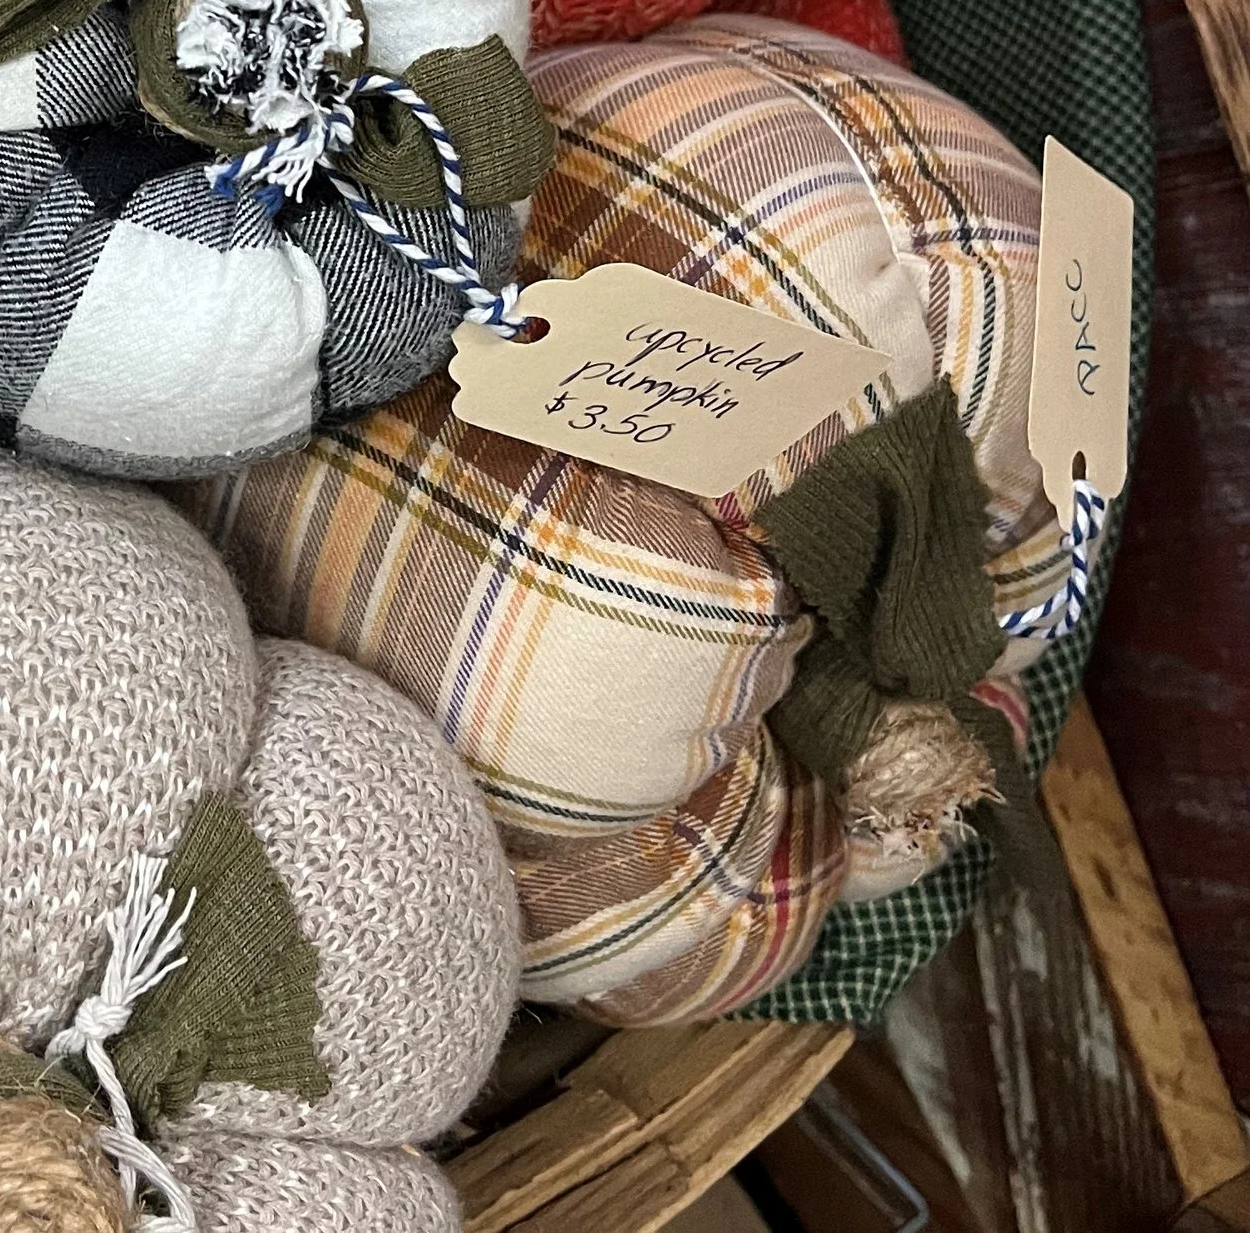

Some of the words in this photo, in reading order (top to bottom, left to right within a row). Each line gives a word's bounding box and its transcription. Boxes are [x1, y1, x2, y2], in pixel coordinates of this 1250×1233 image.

[625, 321, 805, 381] upcycled
[1066, 259, 1100, 396] PACC
[558, 360, 740, 419] pumpkin
